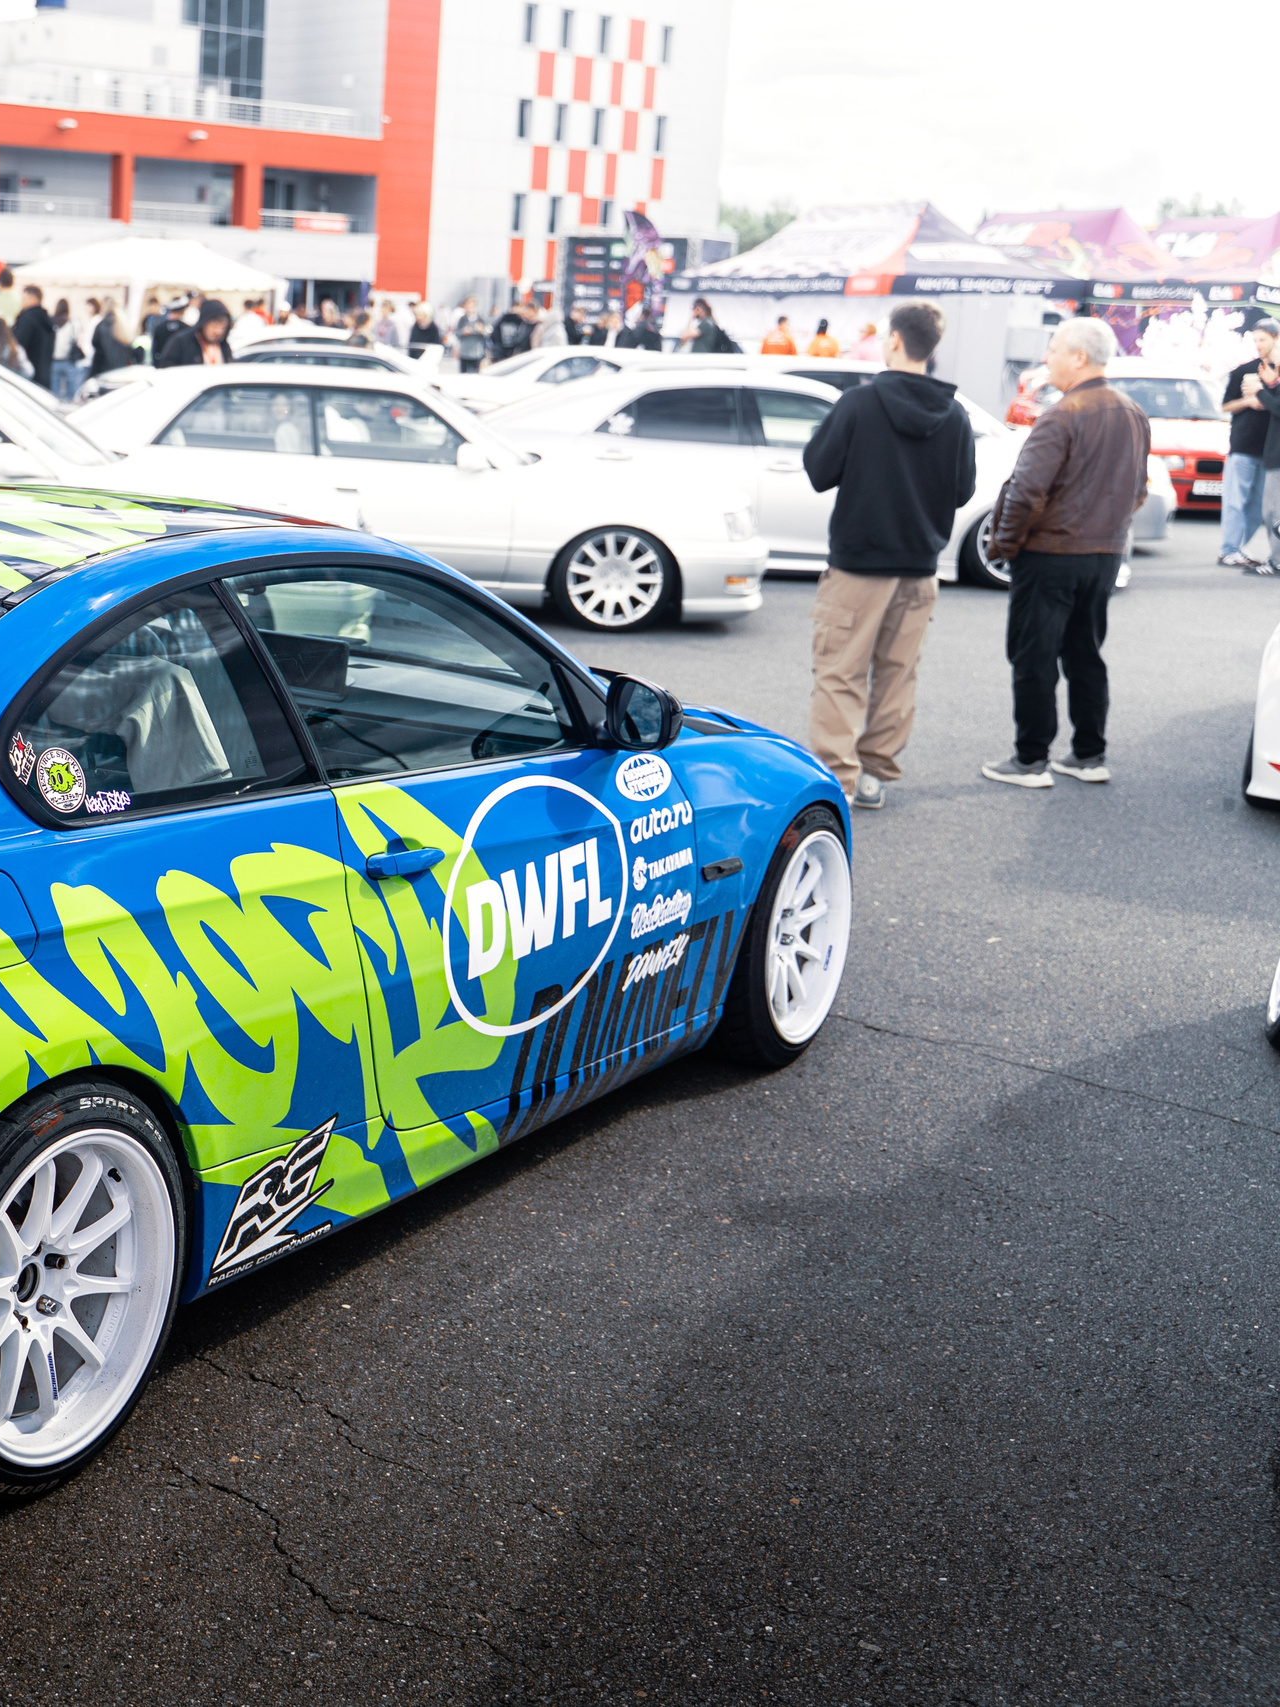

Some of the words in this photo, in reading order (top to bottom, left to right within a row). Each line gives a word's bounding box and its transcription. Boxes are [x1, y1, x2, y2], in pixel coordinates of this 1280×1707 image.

[630, 800, 693, 845] auto.ru
[647, 847, 693, 880] TAKAYAMA
[465, 837, 612, 980] DWFL
[79, 1096, 140, 1115] SPORT
[208, 1260, 254, 1287] RACING
